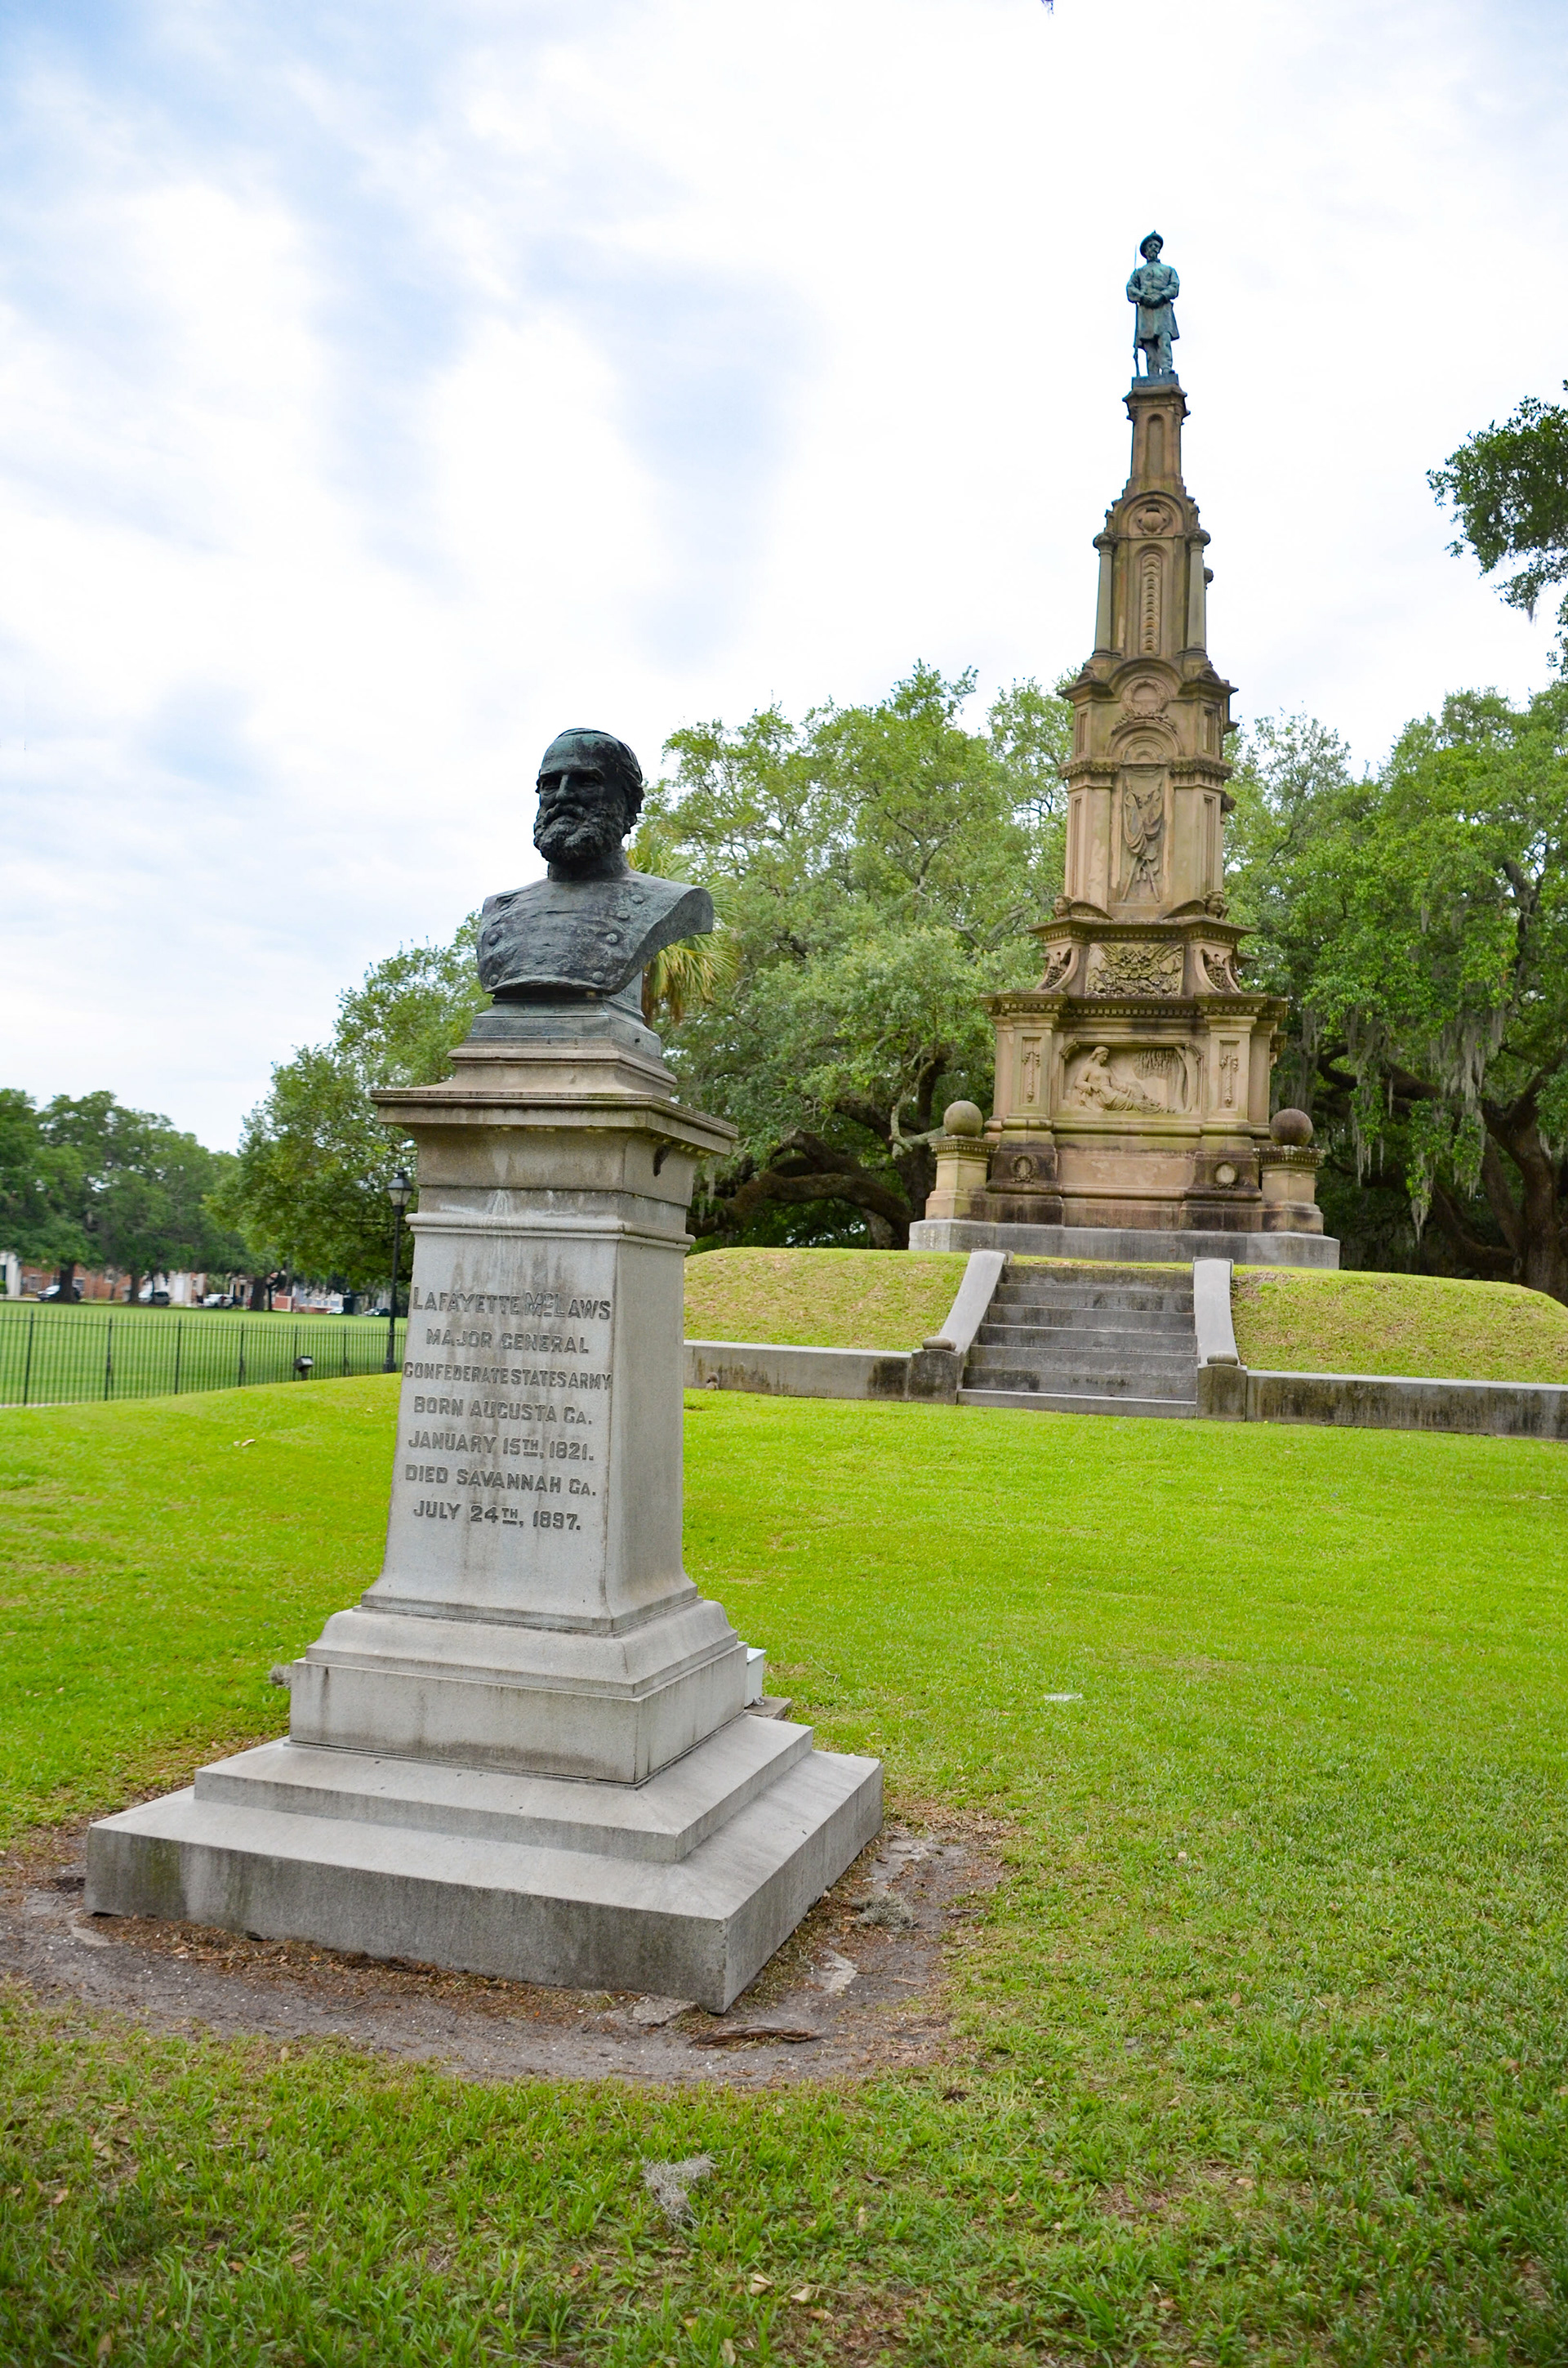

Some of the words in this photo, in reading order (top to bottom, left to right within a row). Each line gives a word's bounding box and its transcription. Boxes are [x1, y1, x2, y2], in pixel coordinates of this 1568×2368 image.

[412, 1287, 520, 1315] LAFAYETTE
[426, 1328, 492, 1349] MAJOR
[501, 1332, 589, 1353] GENERAL
[404, 1362, 509, 1384] CONFEDERATE
[510, 1369, 567, 1386] STATES
[568, 1372, 612, 1389] ARMY
[414, 1396, 463, 1416] BORN
[470, 1400, 557, 1422] AUGUSTA
[408, 1430, 497, 1453] JANUARY
[549, 1441, 594, 1460] 1821.
[405, 1465, 448, 1483] DIED
[457, 1469, 561, 1493] SAVANNAH
[414, 1501, 461, 1519] JULY
[532, 1511, 581, 1531] 1897.
